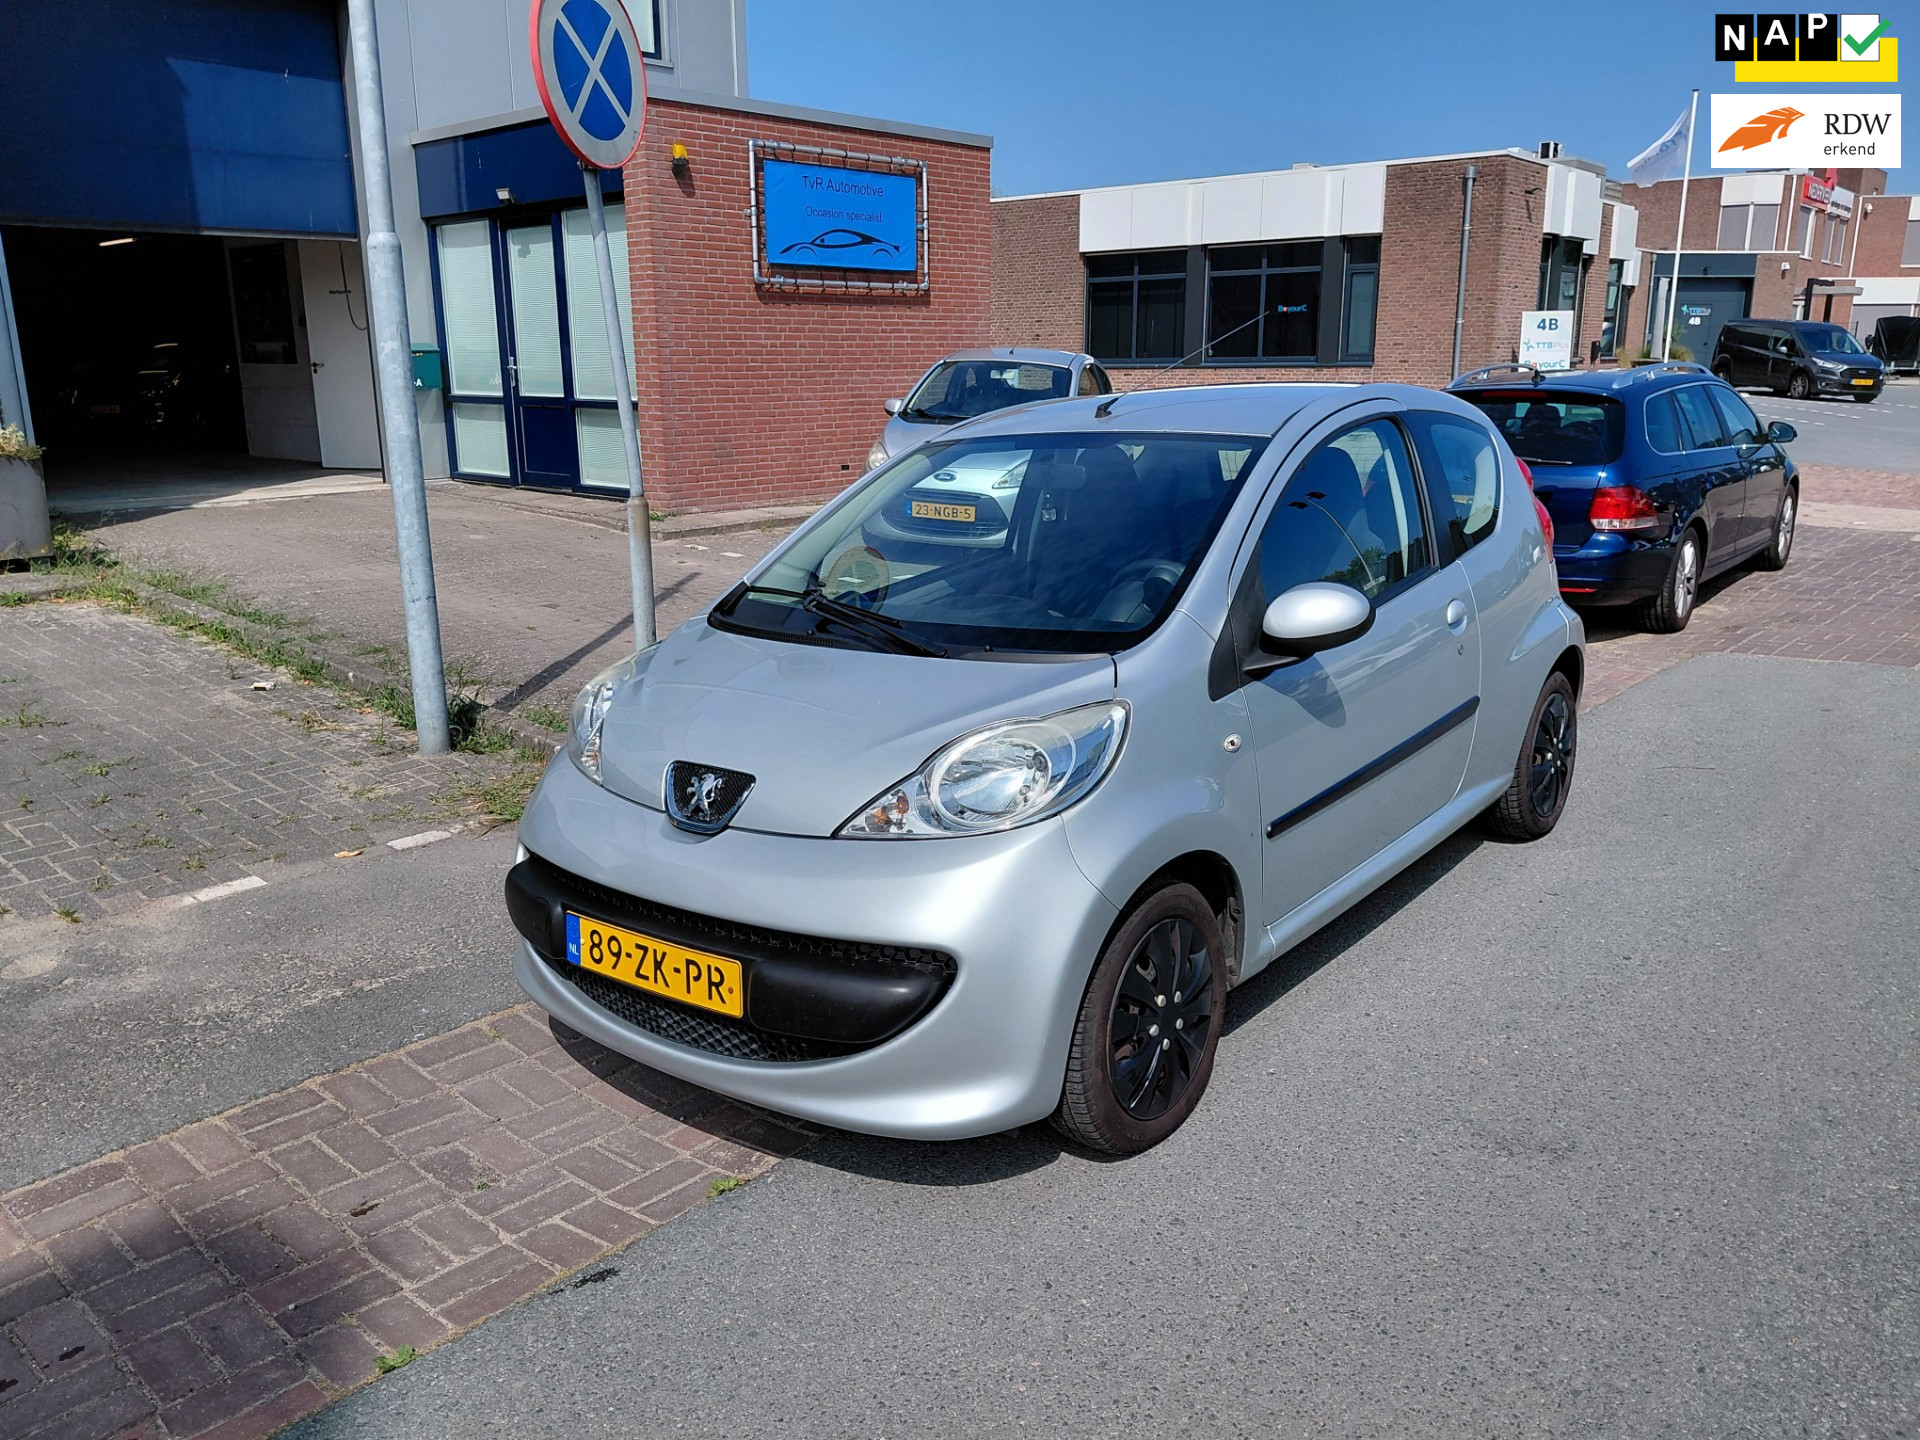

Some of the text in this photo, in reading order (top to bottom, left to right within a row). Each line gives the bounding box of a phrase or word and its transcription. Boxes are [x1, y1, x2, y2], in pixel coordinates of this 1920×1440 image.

[801, 175, 884, 198] TvR Automotive
[805, 205, 883, 223] Occasion specialist
[1537, 318, 1559, 331] 4B
[915, 504, 972, 520] 23-NGB-5
[568, 942, 580, 956] NL
[588, 928, 728, 1005] 89-ZK-PR
